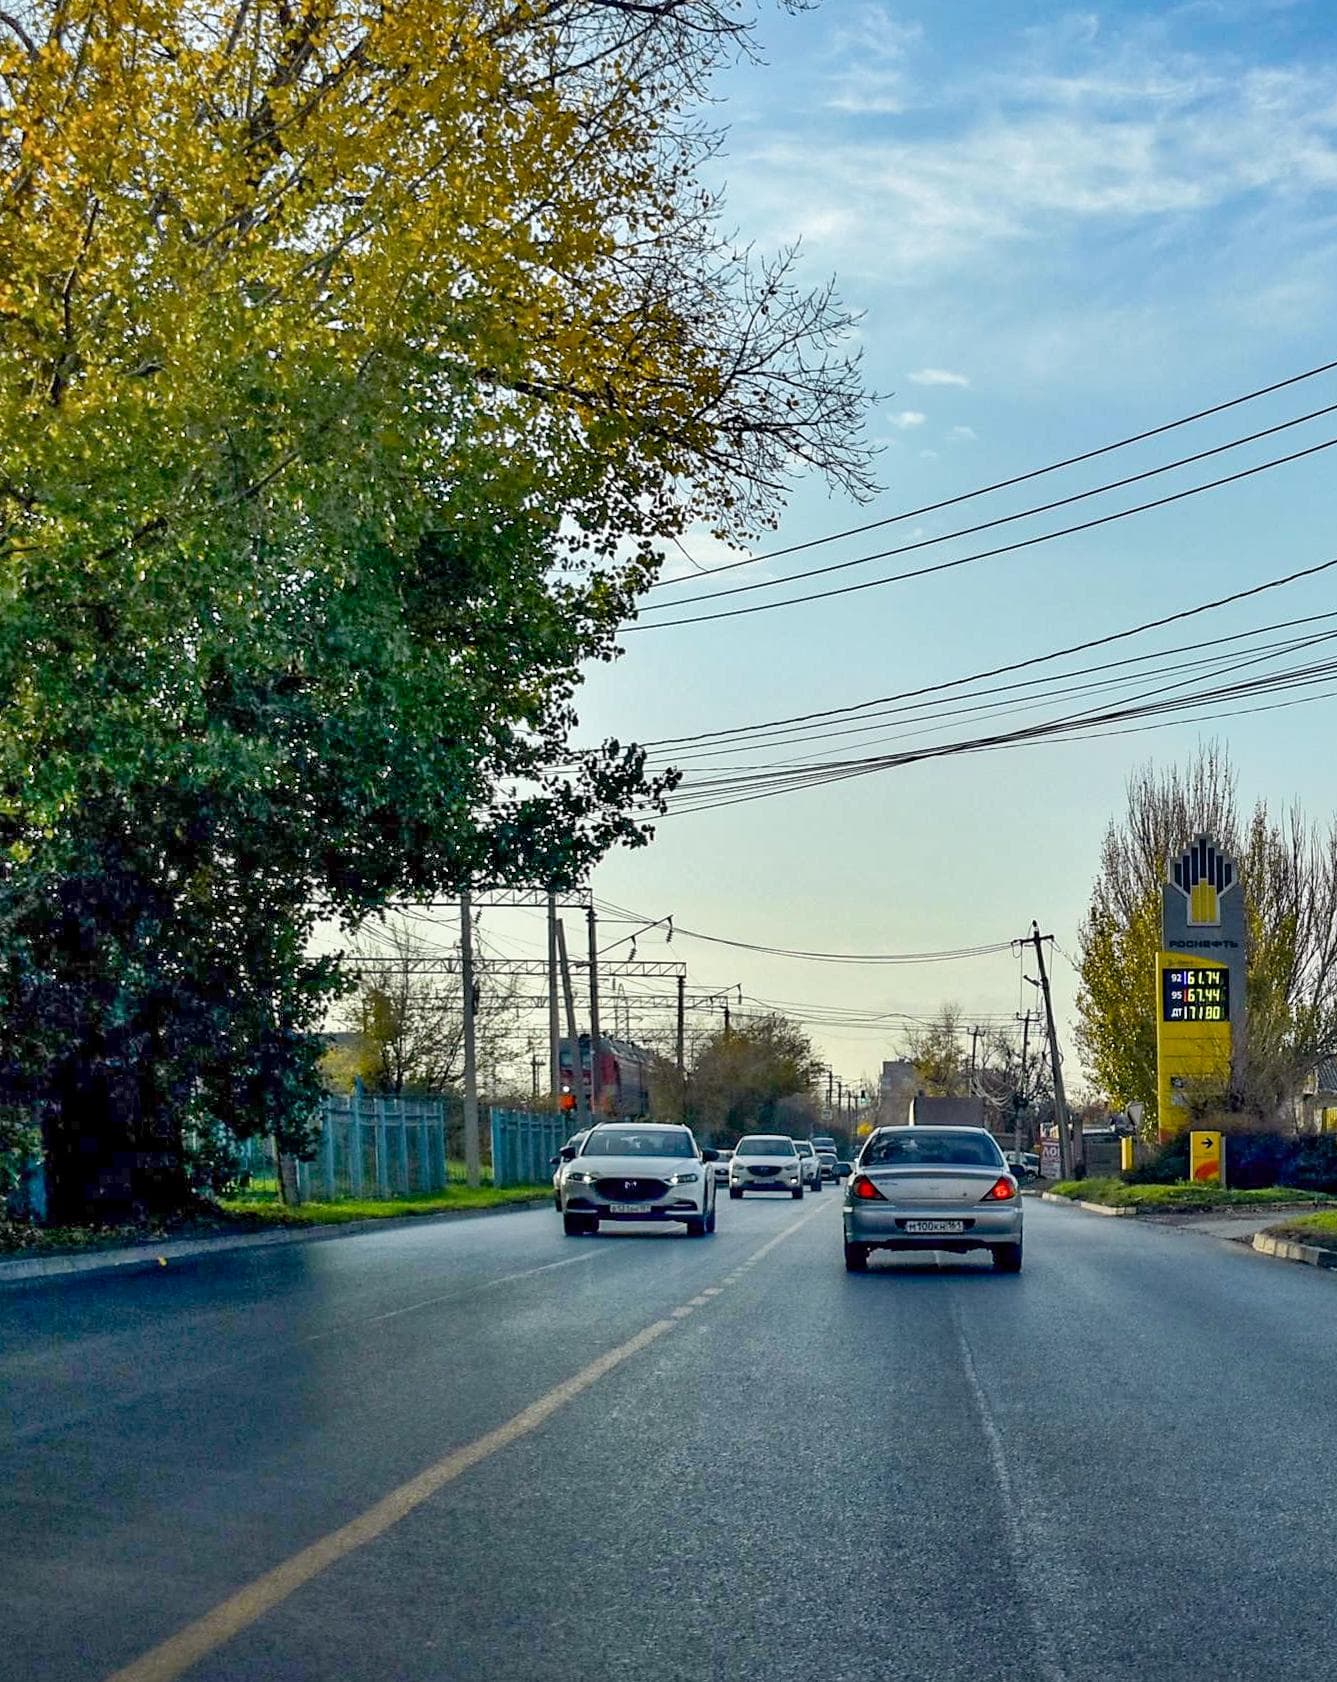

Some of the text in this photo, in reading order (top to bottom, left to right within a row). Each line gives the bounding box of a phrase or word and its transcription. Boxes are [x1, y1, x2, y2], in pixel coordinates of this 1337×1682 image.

[1169, 941, 1238, 949] РОСНЕФТЬ
[1171, 971, 1220, 985] 92 61.74
[1171, 989, 1220, 1002] 95 67.44
[1171, 1007, 1183, 1018] ДТ
